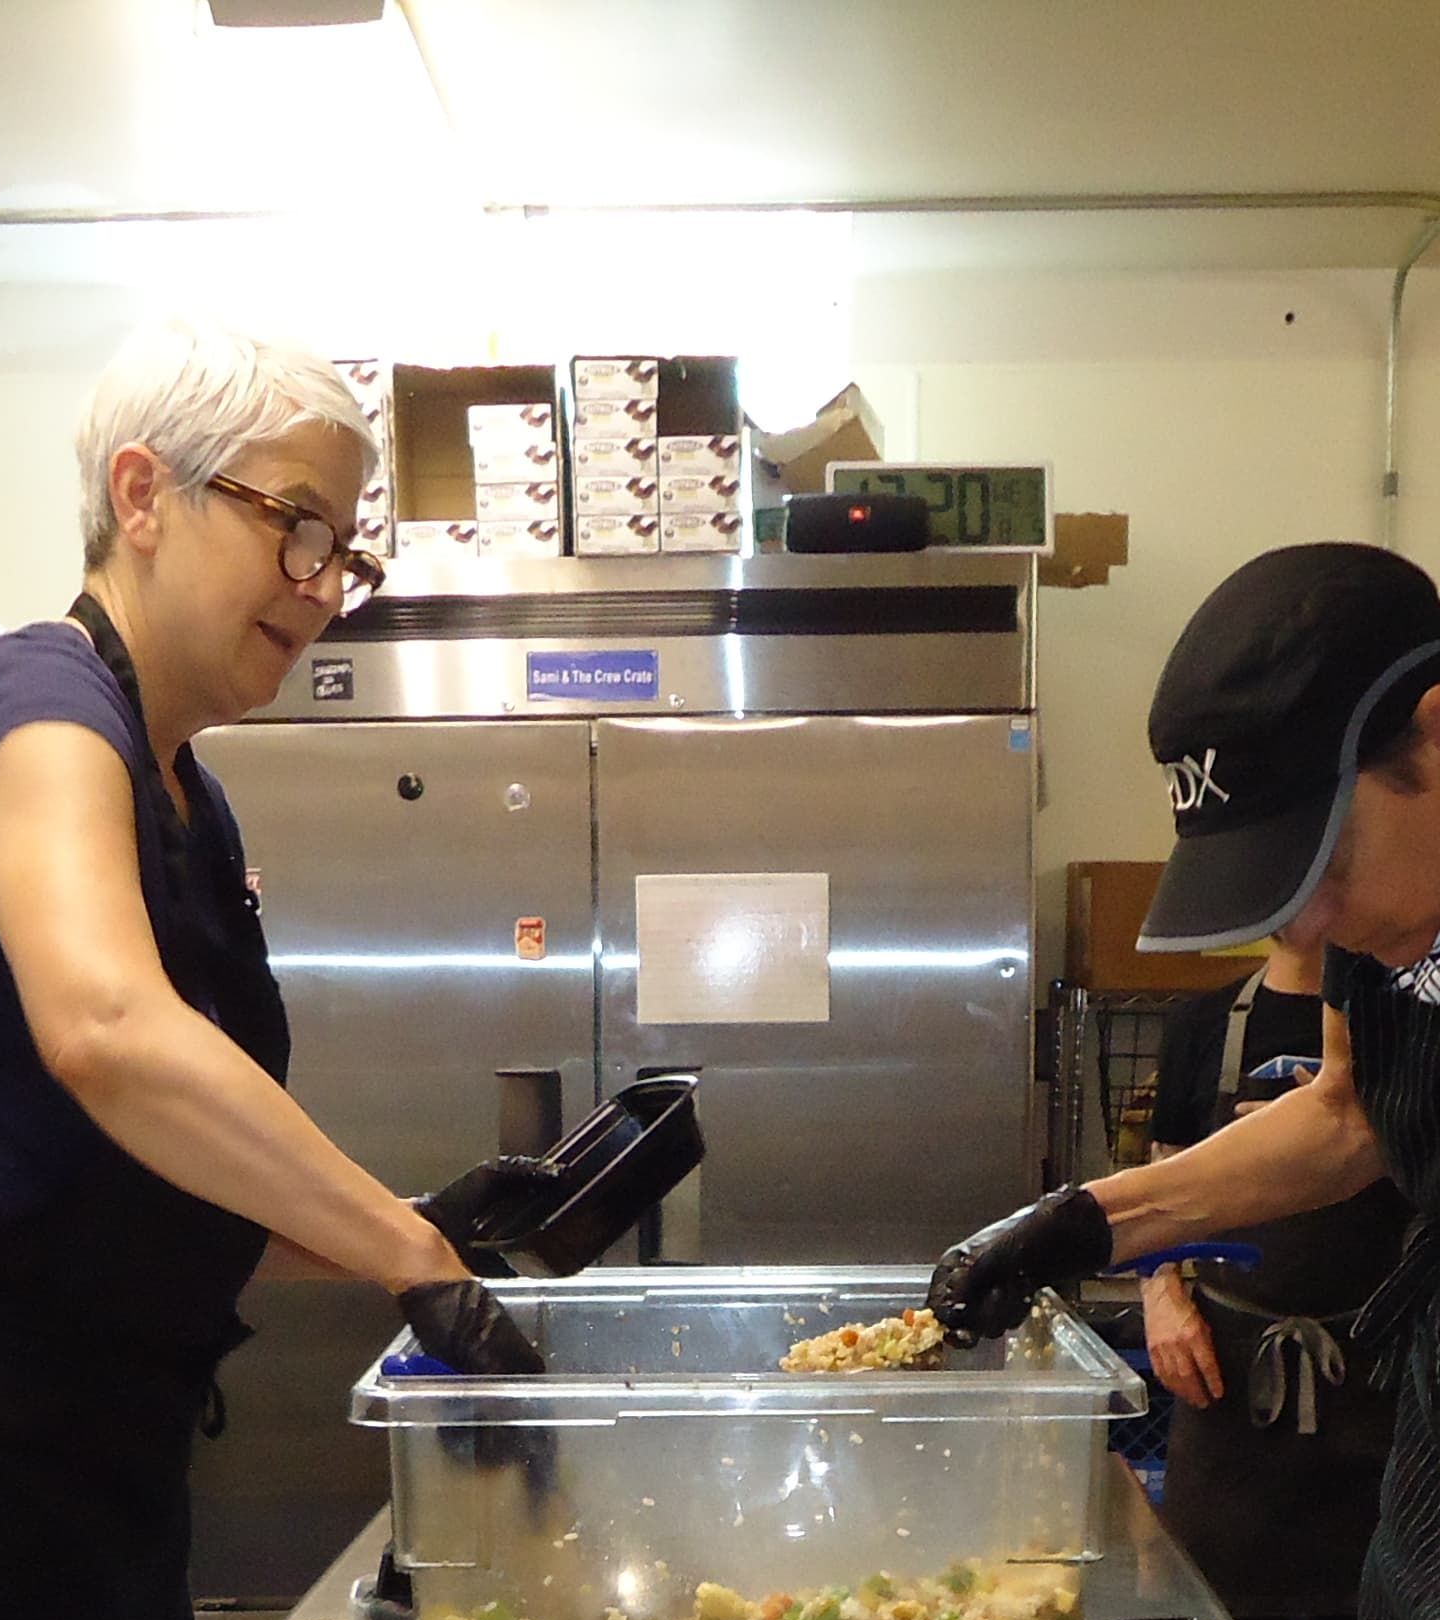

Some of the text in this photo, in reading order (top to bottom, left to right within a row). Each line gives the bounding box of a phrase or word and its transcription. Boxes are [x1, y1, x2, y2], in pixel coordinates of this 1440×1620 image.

[533, 668, 652, 684] Sami & The Crew Crate
